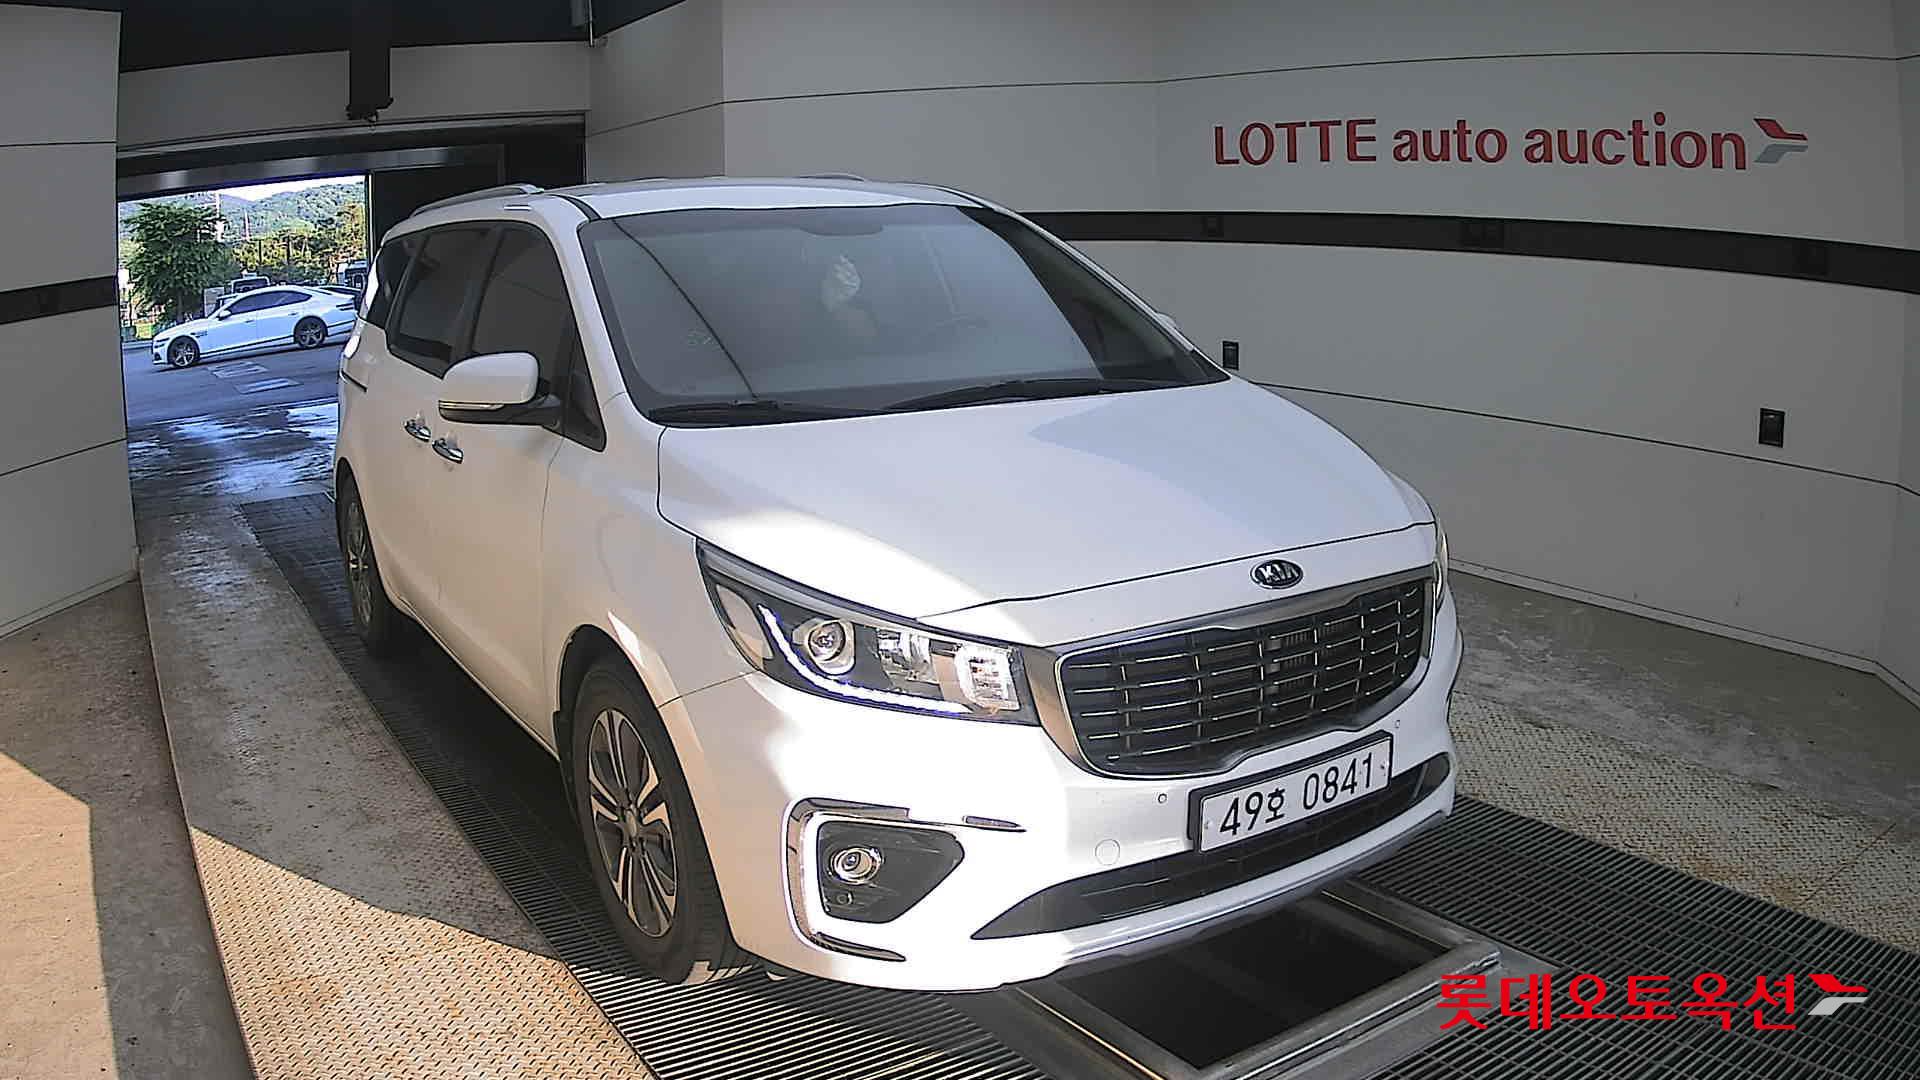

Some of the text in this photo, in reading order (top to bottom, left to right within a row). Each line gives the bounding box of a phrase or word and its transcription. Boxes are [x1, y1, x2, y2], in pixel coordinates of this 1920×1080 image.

[1213, 111, 1747, 171] LOTTE auto auction
[1256, 562, 1300, 584] KIA
[1219, 752, 1373, 836] 49호 0841
